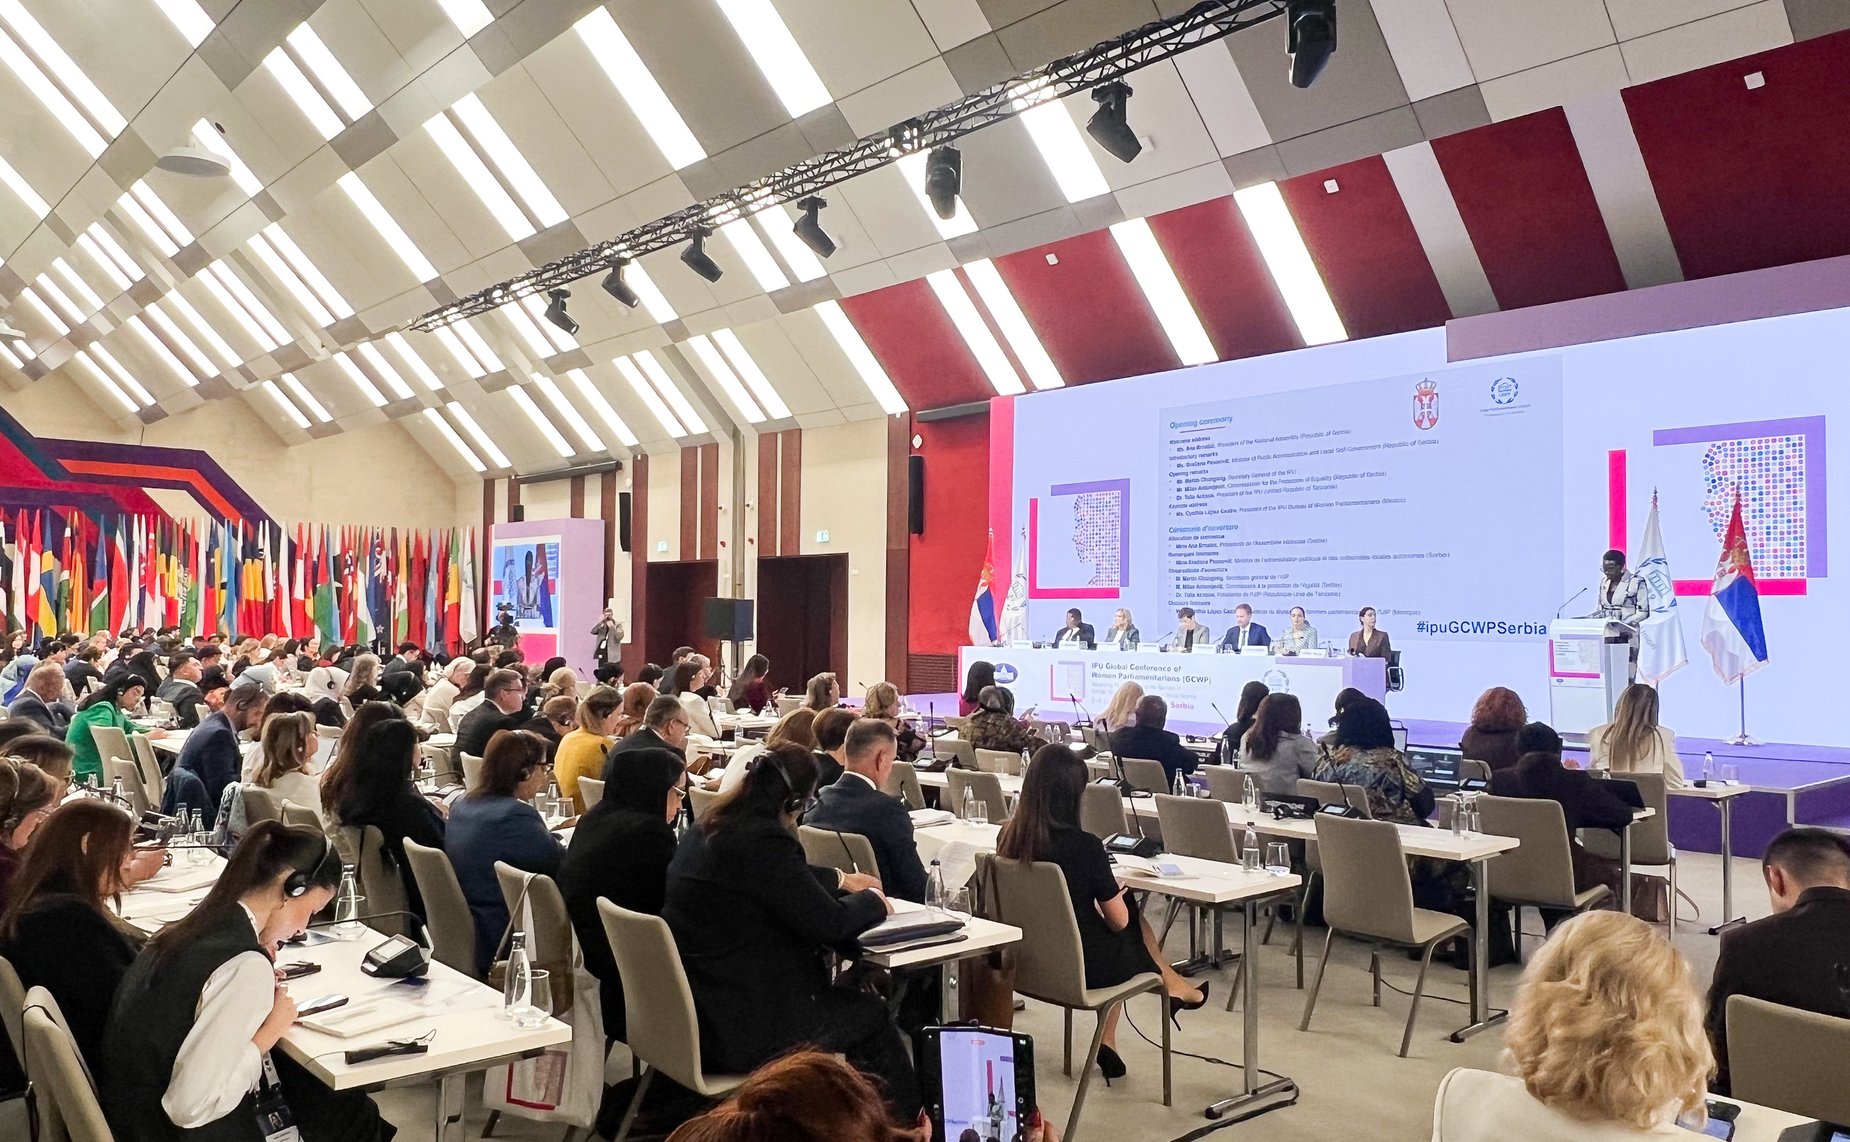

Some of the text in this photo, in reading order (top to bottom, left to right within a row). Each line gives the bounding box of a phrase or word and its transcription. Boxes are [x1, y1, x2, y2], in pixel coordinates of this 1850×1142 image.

[1170, 421, 1198, 429] Opening
[1416, 620, 1547, 636] #ipuGCWPSerbia
[1091, 662, 1104, 670] IPU
[1105, 662, 1128, 670] Global
[1129, 663, 1171, 672] Conference
[1118, 672, 1180, 682] Parliamentarians
[1182, 675, 1212, 686] (GCWP)
[1170, 701, 1195, 710] Serbia
